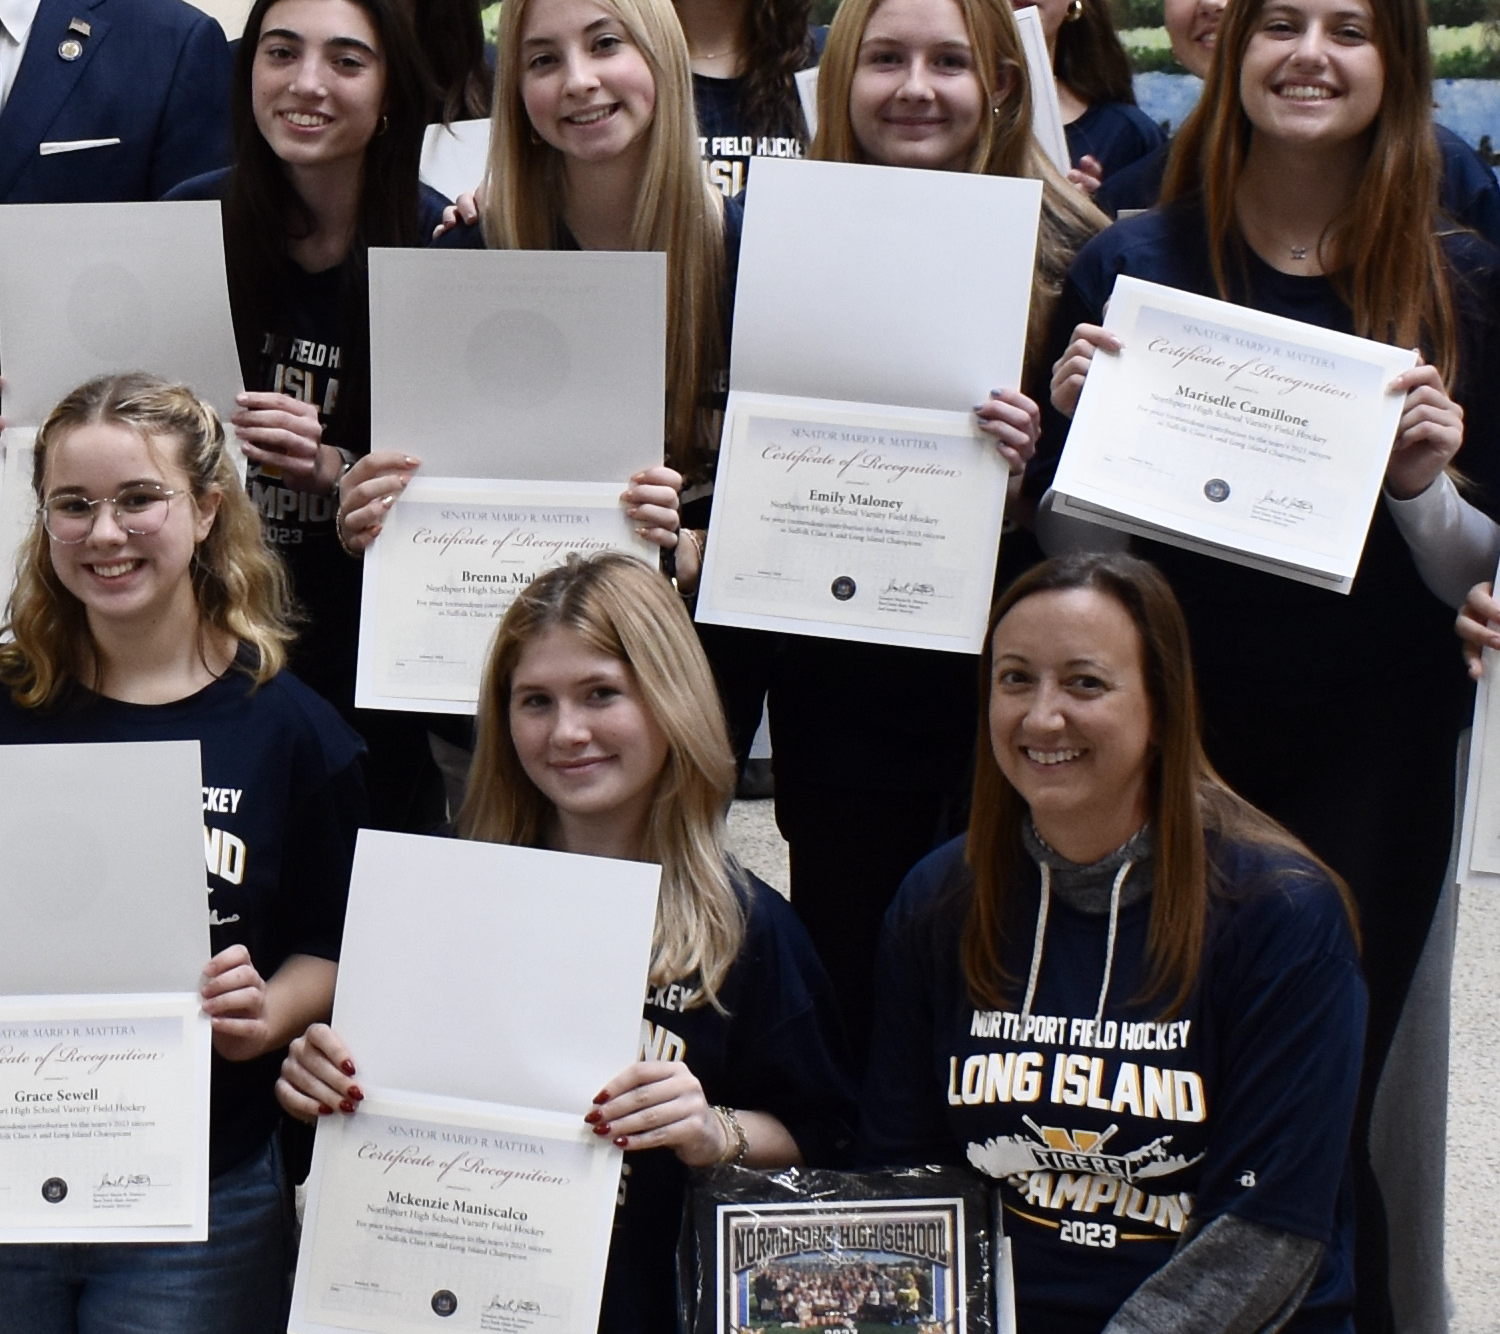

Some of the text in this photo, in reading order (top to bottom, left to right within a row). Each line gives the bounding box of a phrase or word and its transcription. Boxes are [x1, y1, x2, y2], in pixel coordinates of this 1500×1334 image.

[712, 136, 752, 155] FIELD
[1175, 385, 1309, 427] Mariselle Camillone
[809, 489, 903, 511] Emily Maloney
[462, 571, 507, 583] Brenna
[970, 1009, 1190, 1052] NORTHPORT FIELD HOCKEY
[35, 1042, 62, 1074] of
[54, 1046, 164, 1074] Recognition
[14, 1088, 98, 1103] Grace Sewell
[947, 1052, 1206, 1123] LONG ISLAND
[388, 1125, 433, 1141] SENATOR
[436, 1132, 477, 1146] MARIO
[493, 1139, 545, 1155] MATTERA
[357, 1142, 570, 1189] Certificate of Recognition
[1036, 1151, 1129, 1177] TIGERS
[387, 1191, 528, 1222] Mckenzie Maniscalco
[734, 1219, 948, 1269] NORTHPORT HIGH SCHOOL
[1060, 1220, 1116, 1249] 2023
